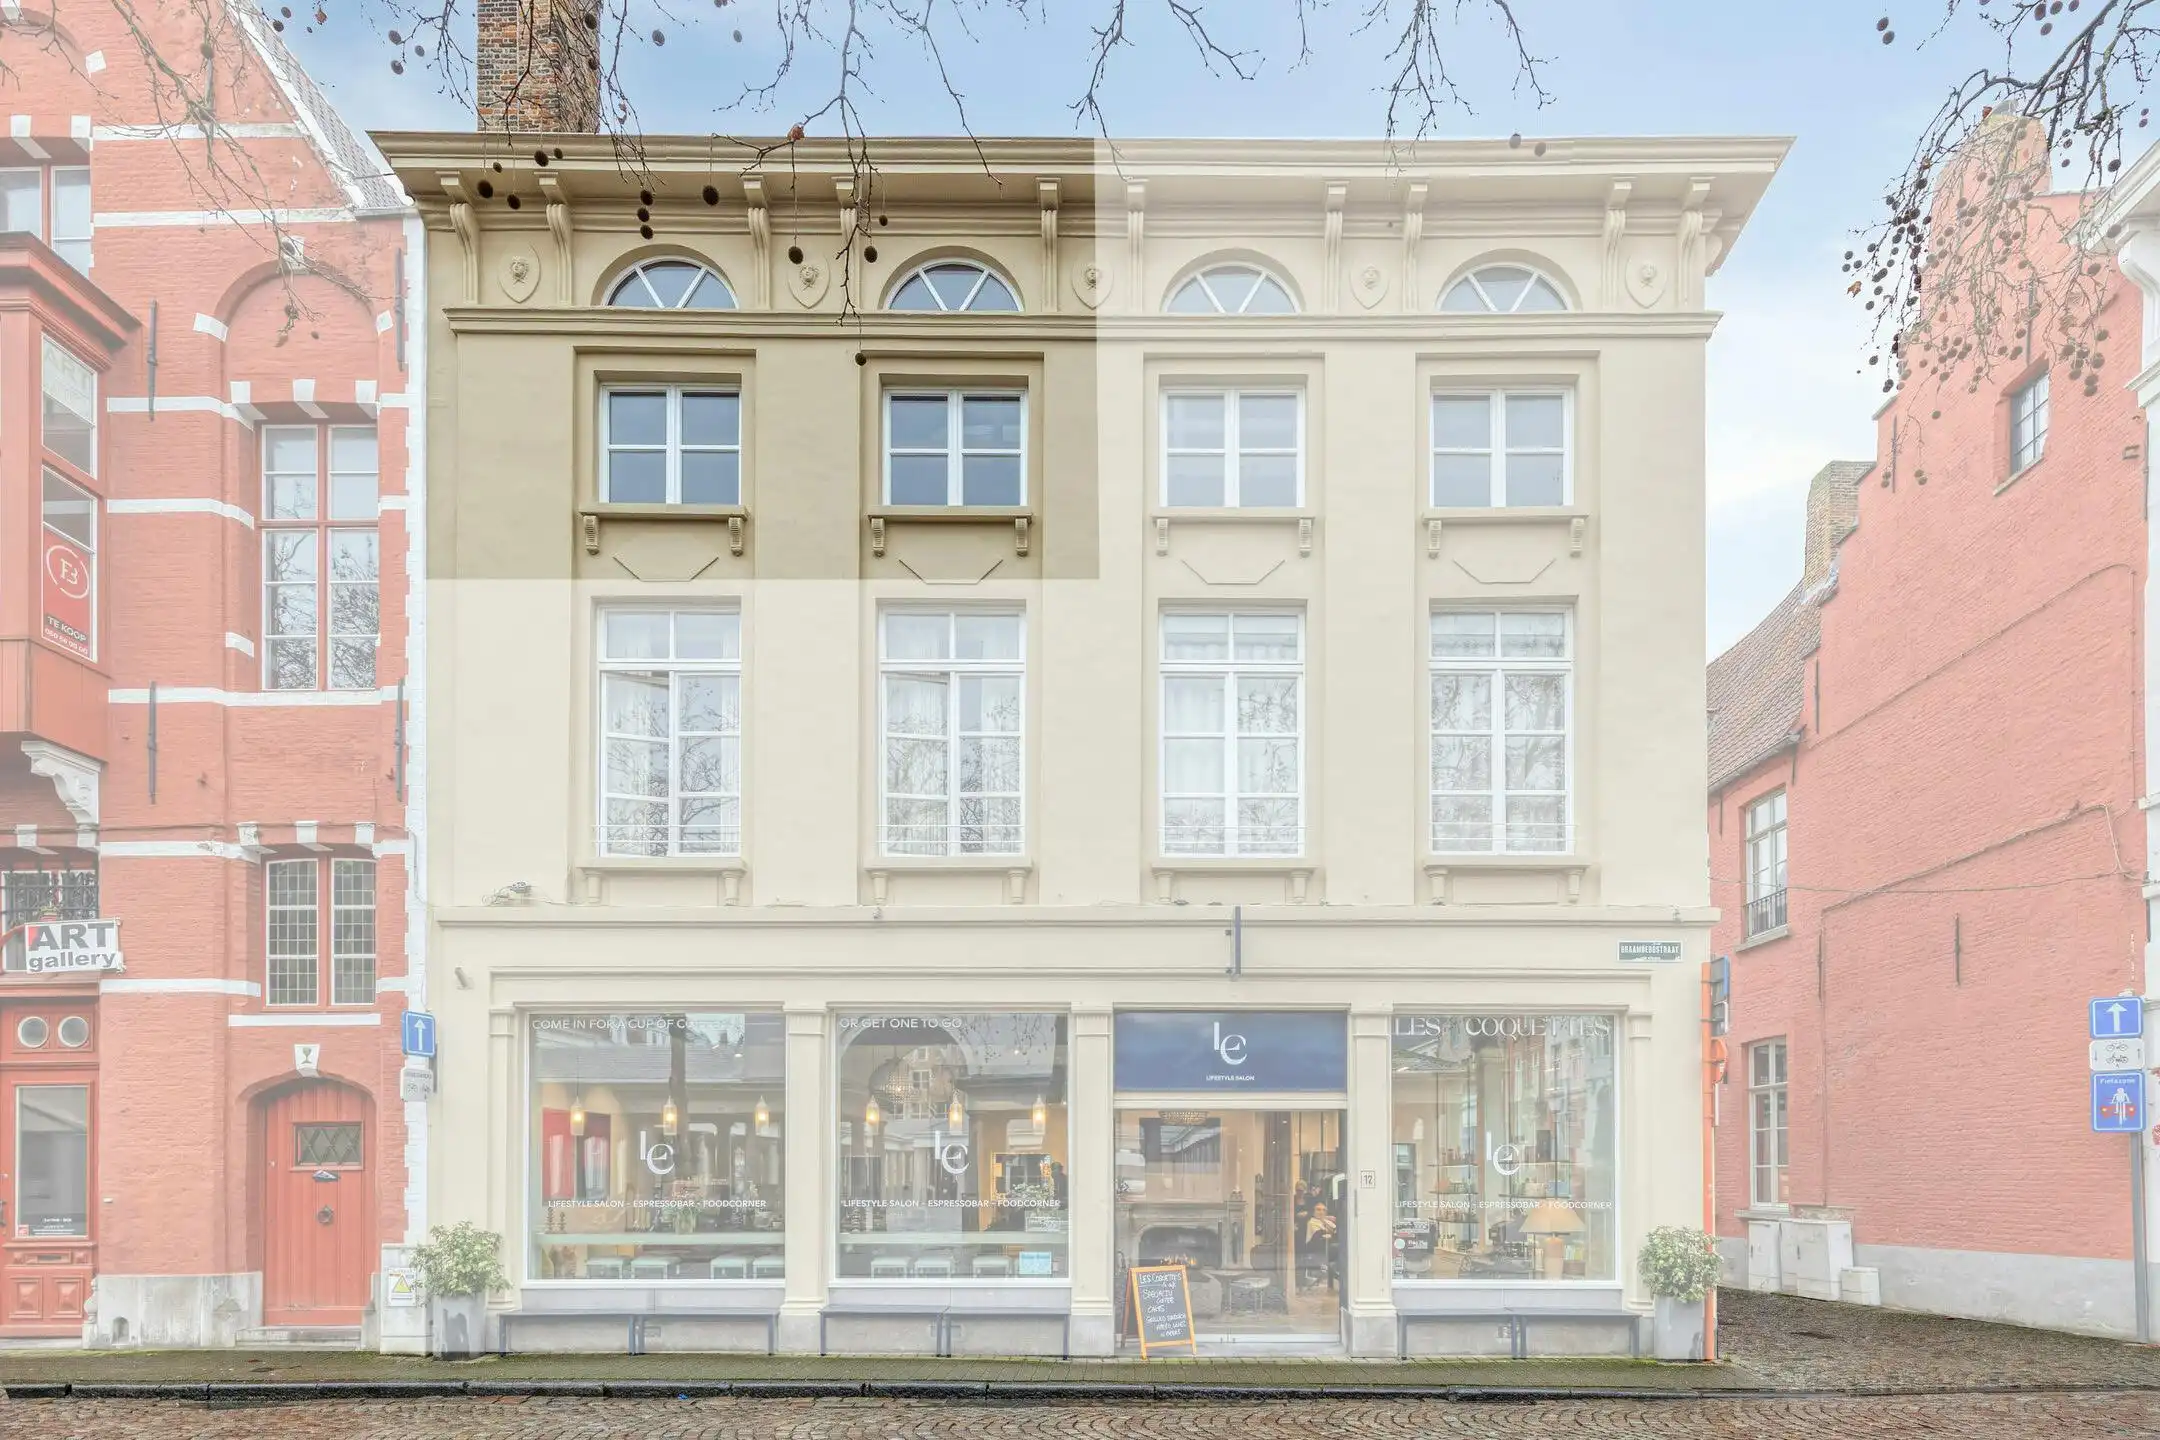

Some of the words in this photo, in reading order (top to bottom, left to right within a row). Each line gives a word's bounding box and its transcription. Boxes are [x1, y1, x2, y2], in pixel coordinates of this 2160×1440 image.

[47, 616, 60, 628] TE
[61, 623, 87, 641] KOOP
[28, 923, 114, 952] ART
[28, 951, 117, 972] gallery
[532, 1019, 569, 1030] COME
[573, 1019, 586, 1030] IN
[589, 1019, 613, 1030] FOR
[628, 1019, 653, 1030] CUP
[657, 1019, 674, 1030] OF
[839, 1018, 858, 1028] OR
[861, 1018, 886, 1028] GET
[889, 1018, 918, 1028] ONE
[921, 1018, 938, 1028] TO
[941, 1018, 962, 1028] GO
[1395, 1017, 1441, 1036] LES
[1465, 1017, 1611, 1040] COQUETTES
[1363, 1174, 1373, 1185] 12
[548, 1200, 592, 1208] LIFESTYLE
[594, 1200, 624, 1208] SALON
[633, 1200, 694, 1208] ESPRESSOBAR
[703, 1200, 767, 1208] FOODCORNER
[843, 1200, 888, 1208] LIFESTYLE
[889, 1200, 919, 1208] SALON
[927, 1200, 989, 1208] ESPRESSOBAR
[997, 1200, 1060, 1208] FOODCORNER
[1395, 1200, 1439, 1209] LIFESTYLE
[1440, 1200, 1470, 1209] SALON
[1478, 1200, 1540, 1209] ESPRESSOBAR
[1548, 1200, 1612, 1209] FOODCORNER
